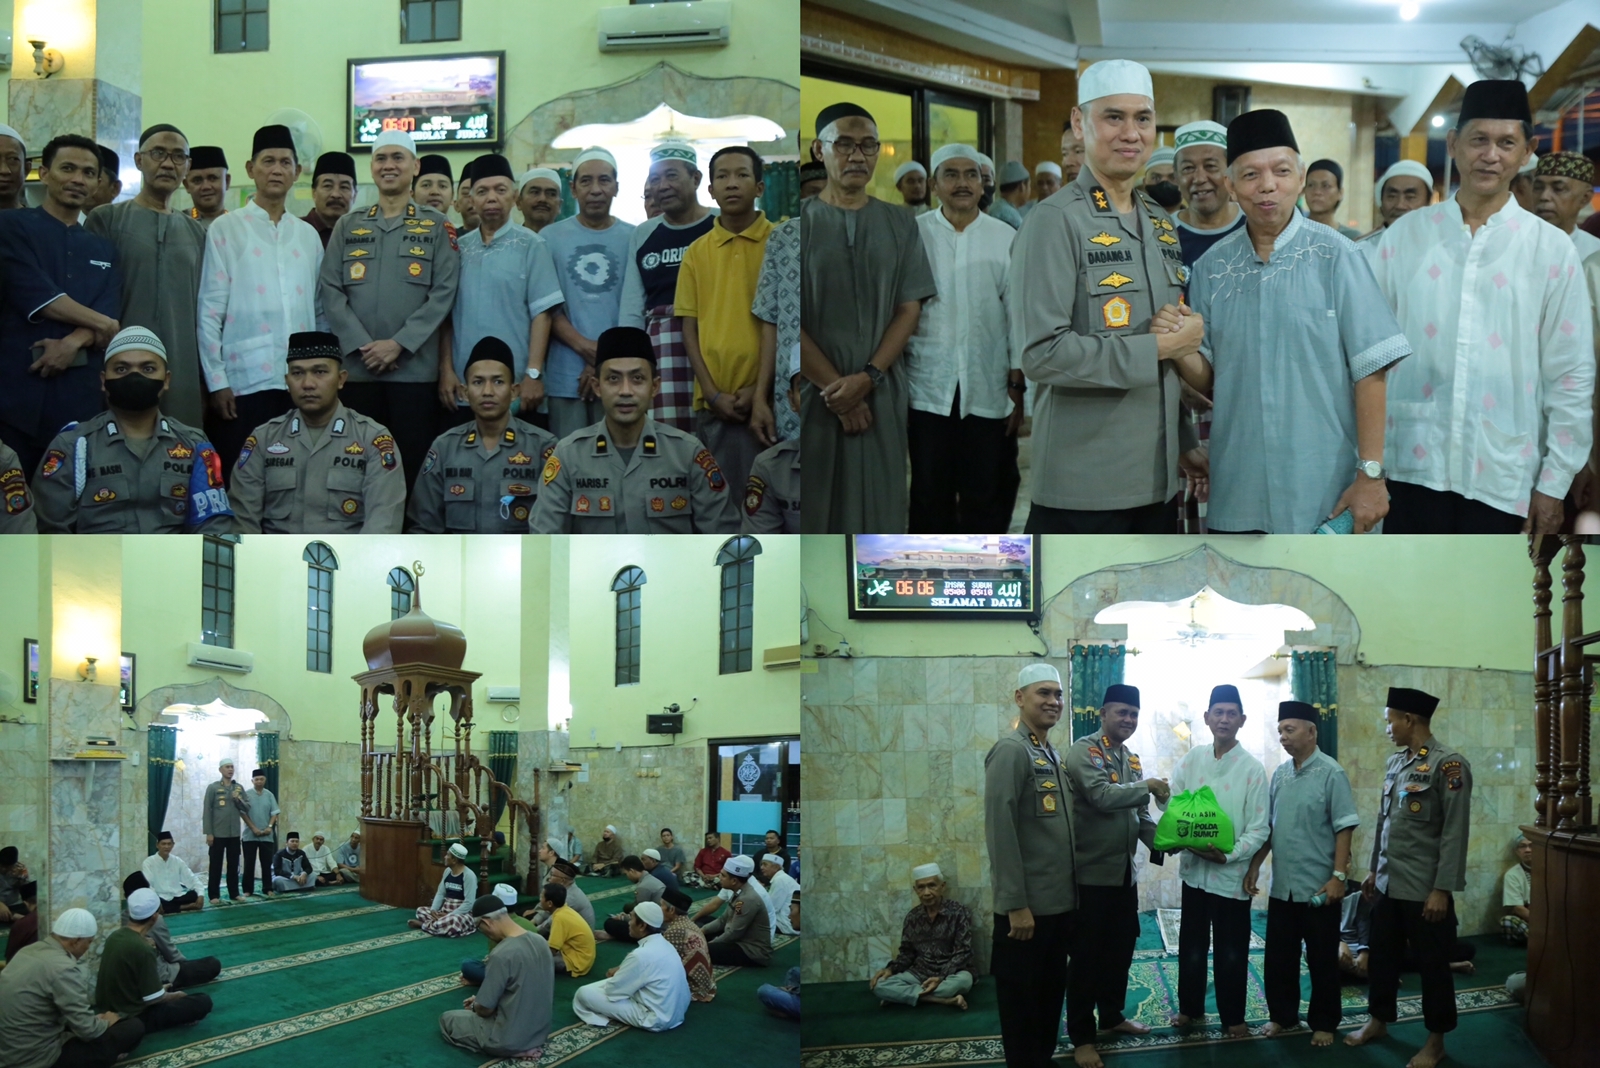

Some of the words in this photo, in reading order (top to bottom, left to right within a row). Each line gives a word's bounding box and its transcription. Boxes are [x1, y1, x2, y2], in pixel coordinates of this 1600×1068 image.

[402, 235, 434, 244] POLRI
[1088, 250, 1133, 265] DADANG.H
[264, 457, 295, 468] SIREGAR
[0, 469, 22, 483] POLDA
[503, 467, 536, 480] POLRI
[576, 478, 610, 489] HARIS.F
[650, 476, 687, 489] POLRI
[971, 581, 993, 589] SUBUH
[930, 597, 986, 607] SELAMAT
[990, 598, 1022, 607] DATA
[1408, 773, 1431, 783] POLRI
[1194, 823, 1219, 831] POLDA
[1192, 830, 1219, 838] SUMUT
